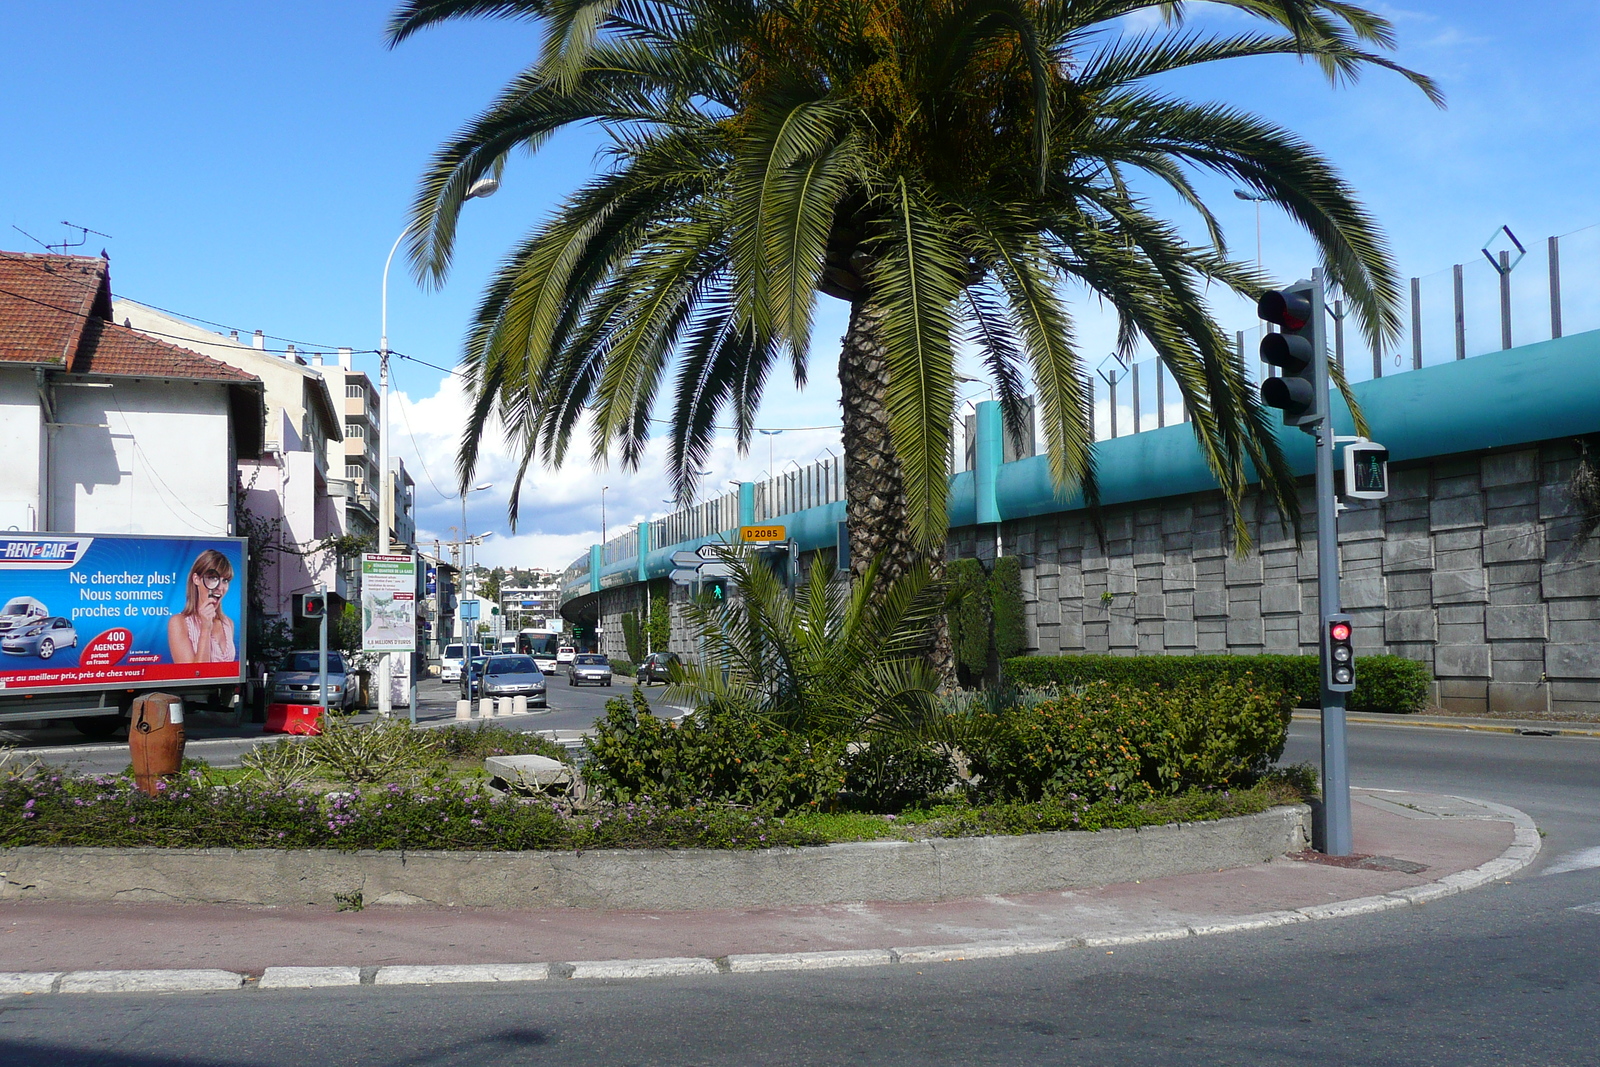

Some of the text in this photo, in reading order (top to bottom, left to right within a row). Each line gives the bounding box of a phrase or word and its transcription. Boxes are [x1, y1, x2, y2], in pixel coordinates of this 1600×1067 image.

[747, 530, 778, 538] D 2085
[5, 543, 38, 557] RENT
[41, 543, 67, 558] CAR
[70, 571, 87, 584] Ne
[91, 571, 144, 584] cherchez
[80, 588, 163, 600] Nous sommes
[72, 604, 173, 620] proches de vous.
[107, 632, 125, 641] 400
[93, 643, 125, 651] AGENCES
[28, 673, 59, 681] meilleur
[60, 672, 77, 681] prix,
[79, 671, 94, 680] près
[106, 669, 122, 677] chez
